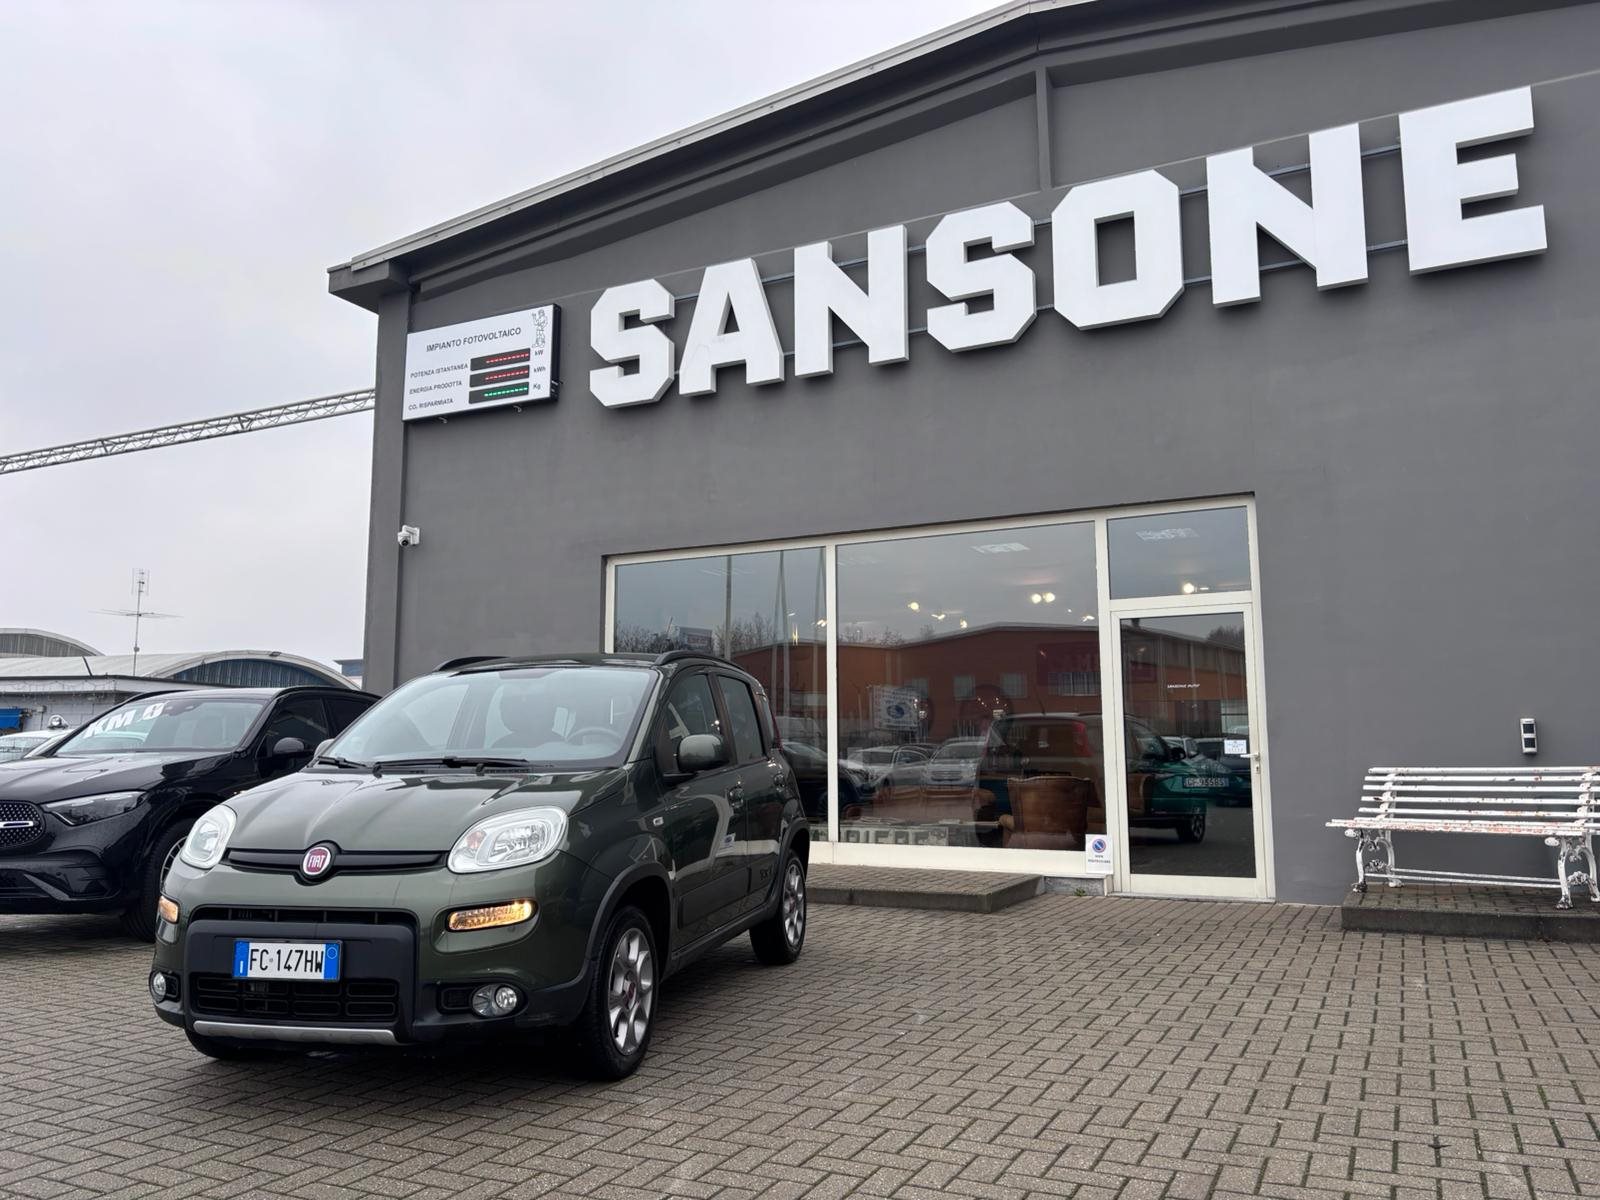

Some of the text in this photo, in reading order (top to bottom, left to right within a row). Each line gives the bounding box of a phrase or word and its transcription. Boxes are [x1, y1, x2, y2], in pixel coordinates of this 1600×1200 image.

[590, 86, 1547, 408] SANSONE
[426, 327, 522, 352] IMPIANTO FOTOVOLTAICO
[410, 363, 468, 378] POTENZA ISTANTANEA
[409, 380, 462, 394] ENERGIA PRODOTTA
[83, 709, 137, 739] KM
[308, 854, 326, 868] FIAT
